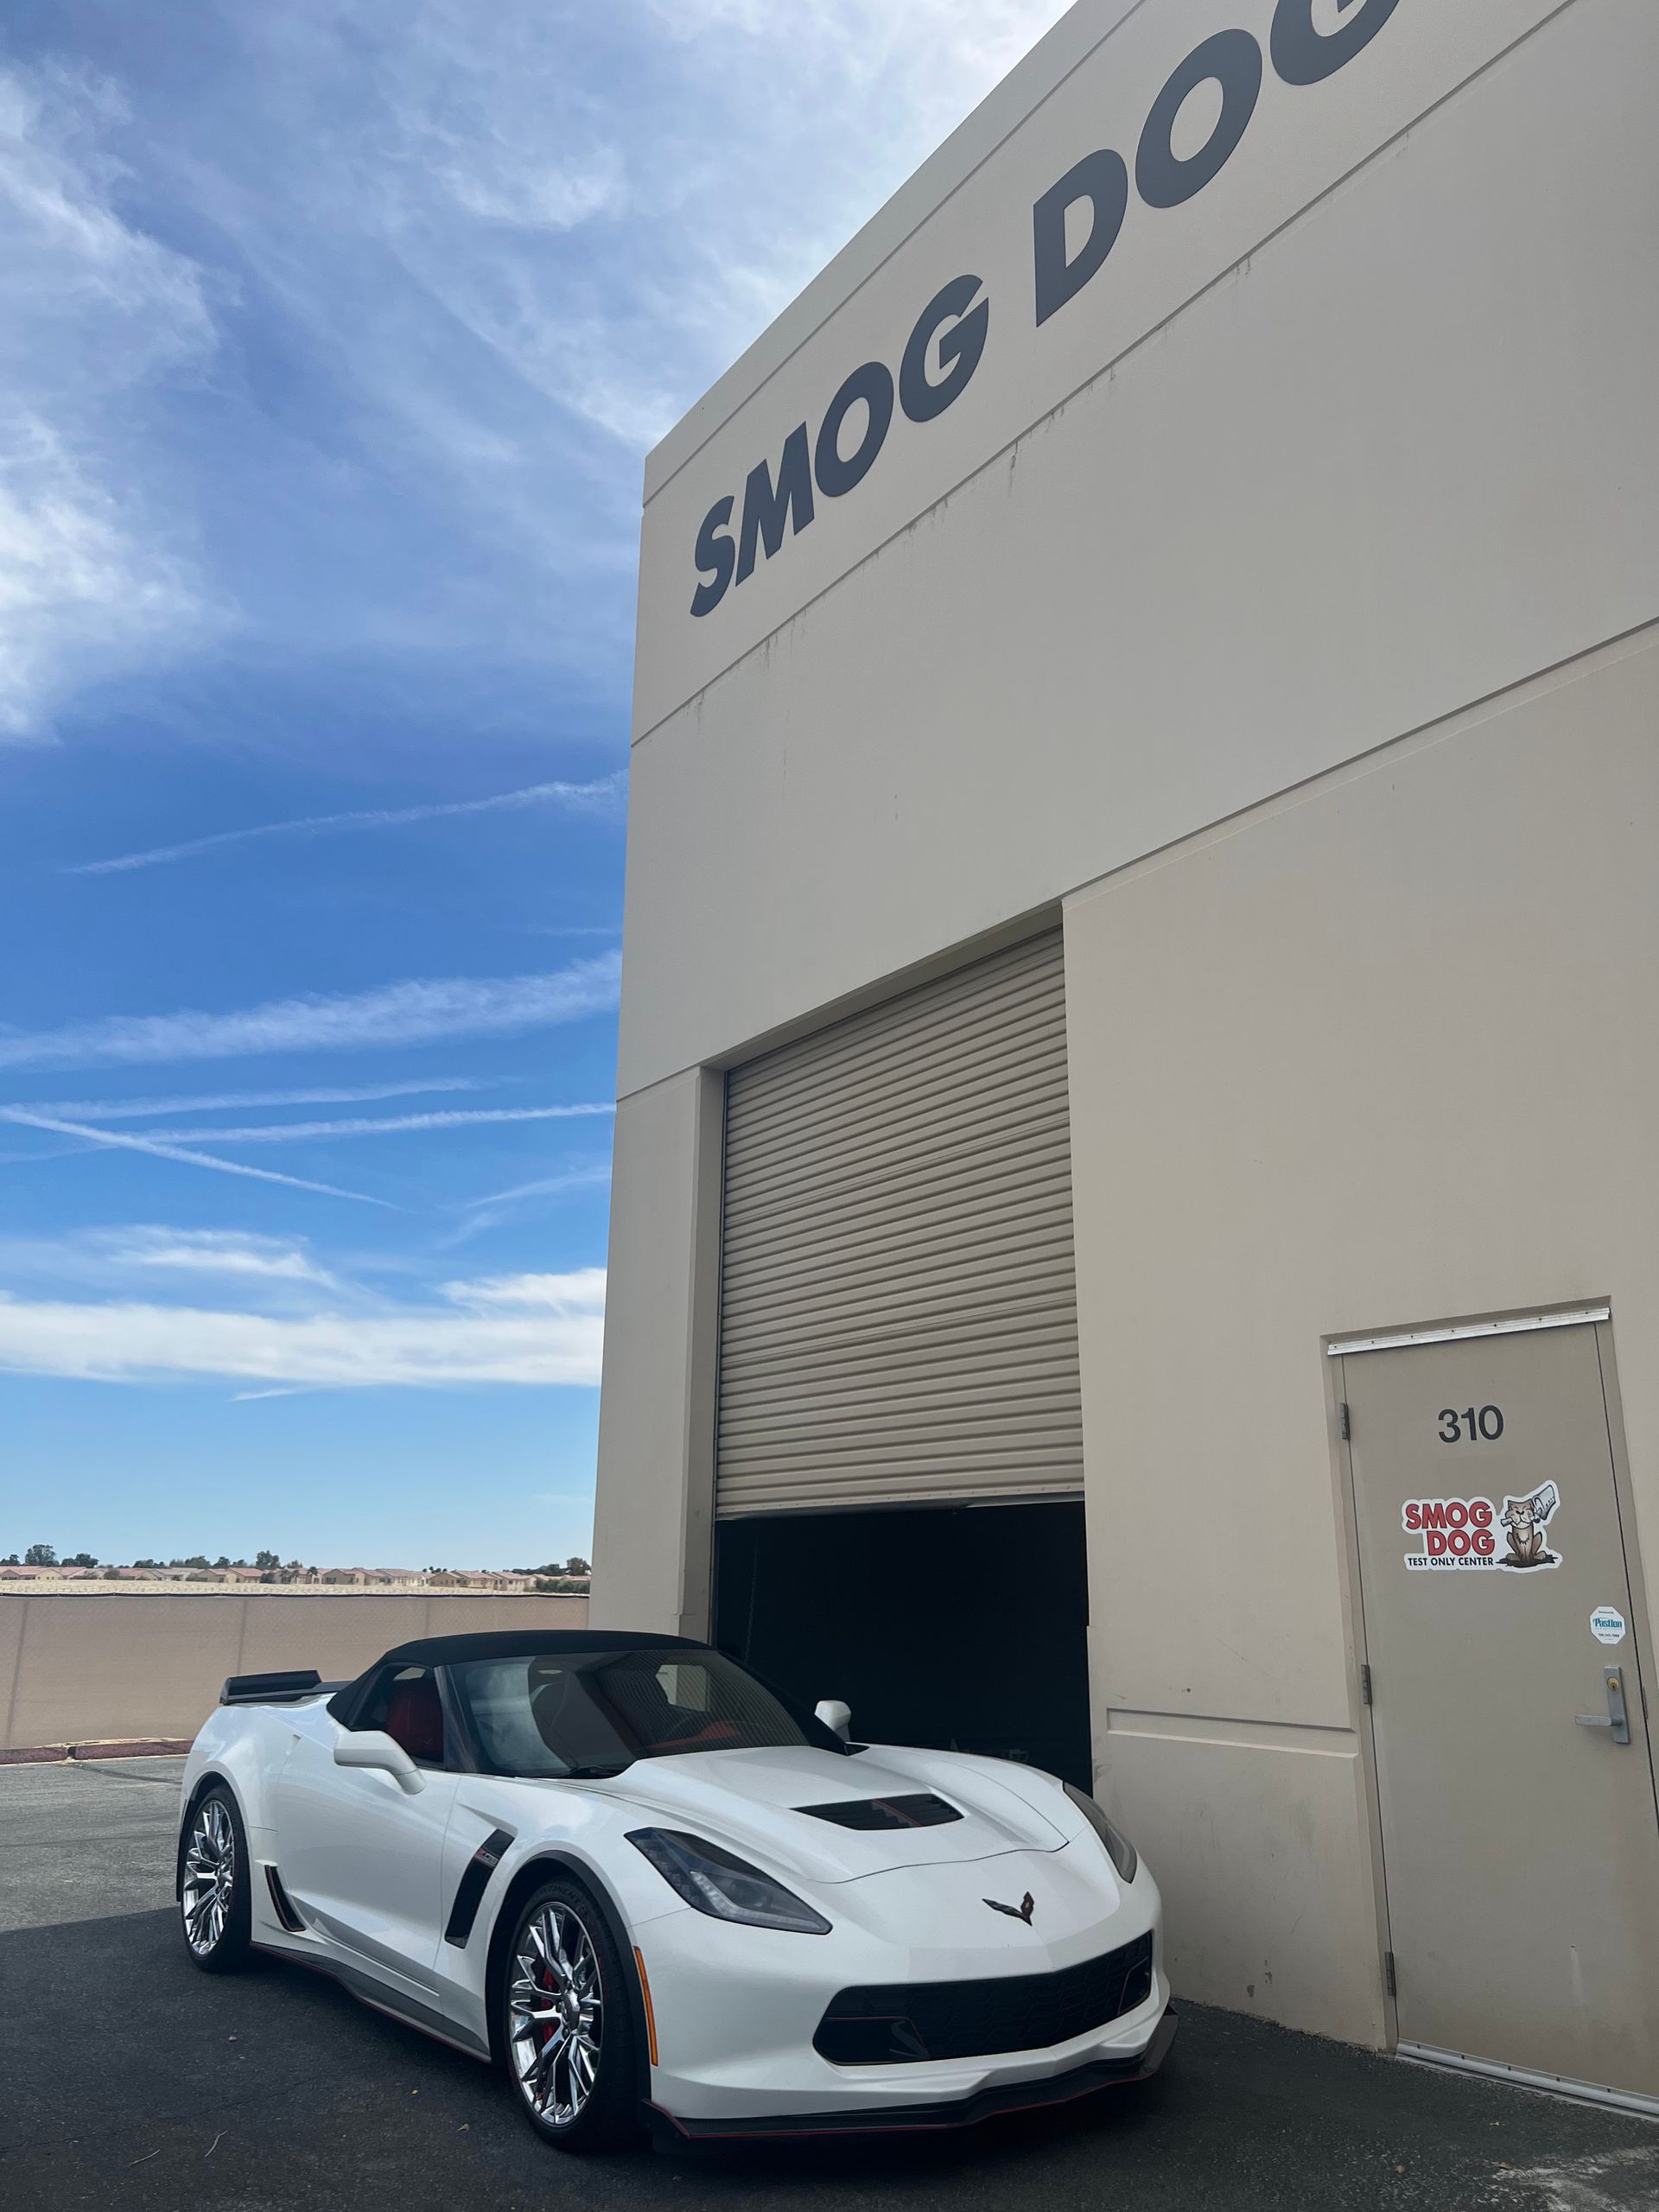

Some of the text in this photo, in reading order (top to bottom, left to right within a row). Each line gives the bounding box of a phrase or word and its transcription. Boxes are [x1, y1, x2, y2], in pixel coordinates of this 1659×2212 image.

[690, 274, 989, 617] SMOG
[1438, 1404, 1503, 1443] 310
[1405, 1501, 1493, 1530] SMOG
[1427, 1529, 1496, 1556] DOG
[1408, 1556, 1494, 1567] TEST ONLY CENTER
